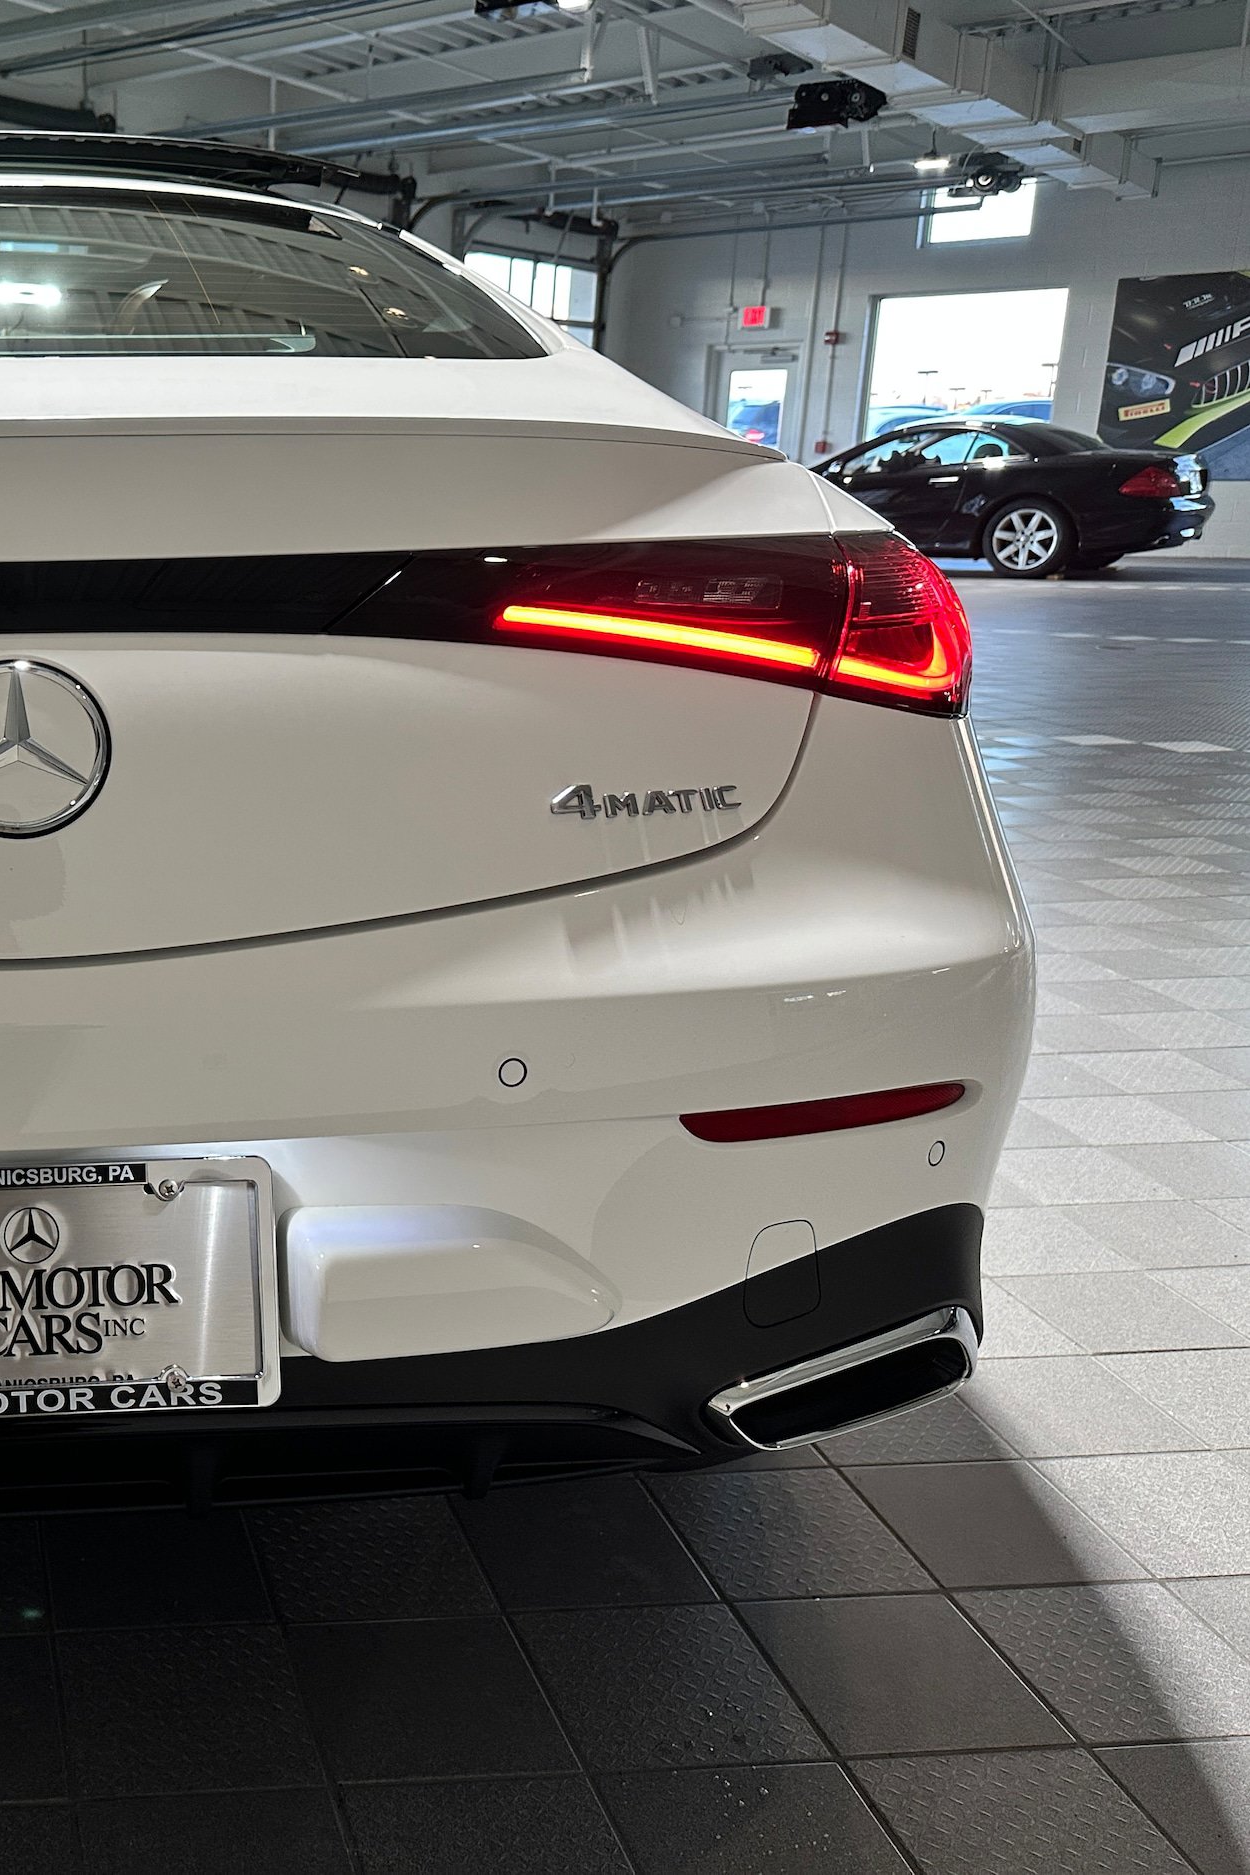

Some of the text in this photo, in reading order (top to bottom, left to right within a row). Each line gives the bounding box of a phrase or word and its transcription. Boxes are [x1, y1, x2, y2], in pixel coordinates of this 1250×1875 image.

[550, 784, 742, 820] 4MATIC
[108, 1165, 135, 1181] PA
[104, 1318, 145, 1337] INC
[110, 1382, 223, 1409] CARS
